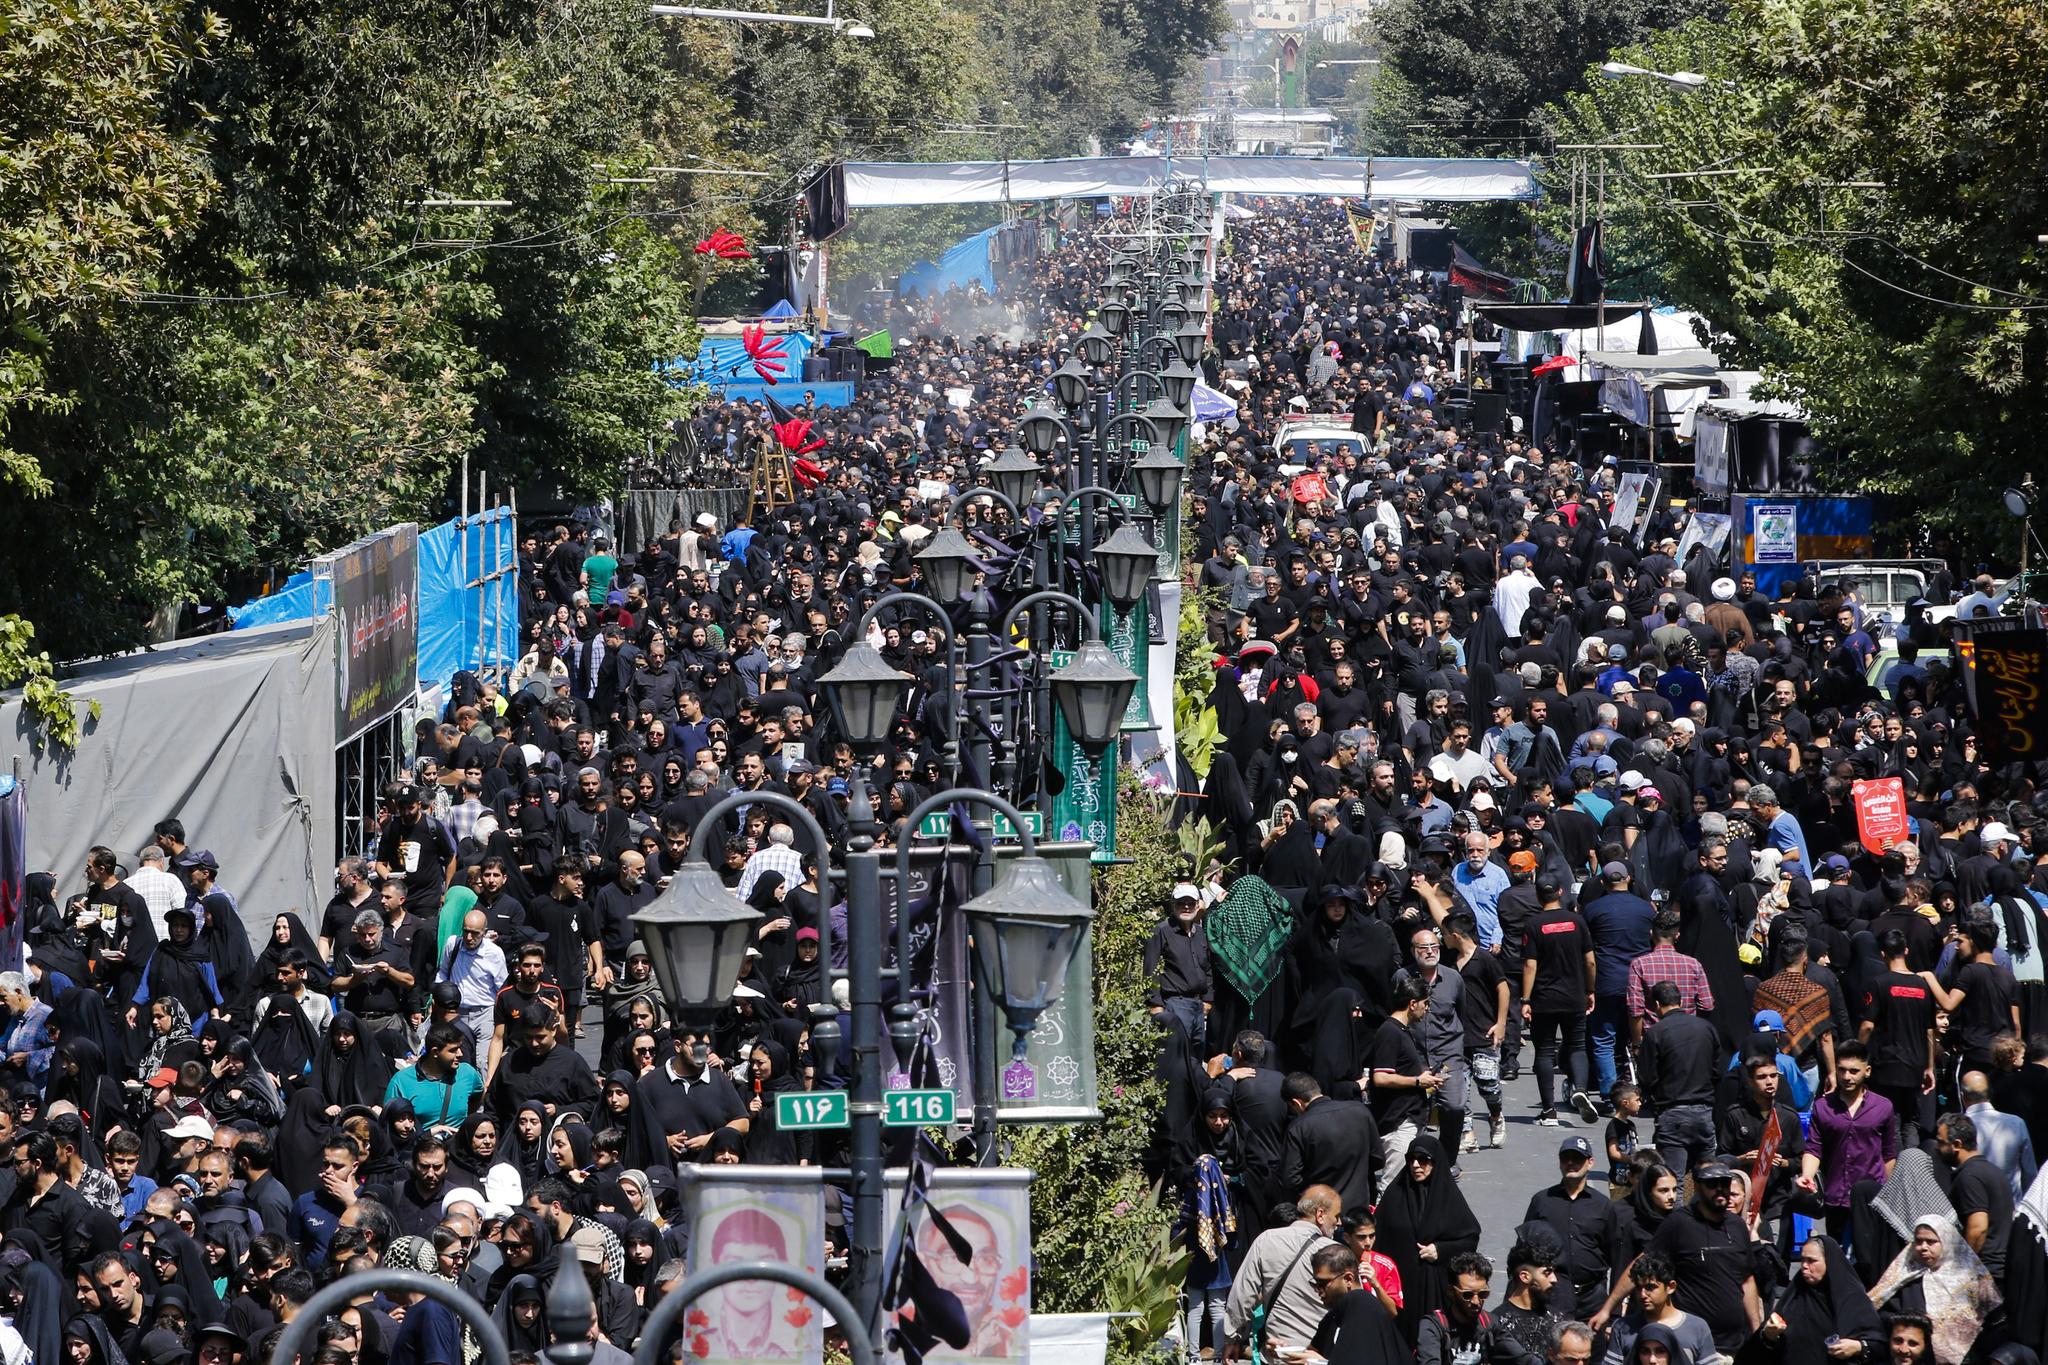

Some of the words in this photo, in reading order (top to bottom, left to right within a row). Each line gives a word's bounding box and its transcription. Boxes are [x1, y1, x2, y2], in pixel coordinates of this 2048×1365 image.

[1056, 653, 1072, 667] 11
[1001, 816, 1035, 833] 15
[792, 1097, 834, 1123] ۱۱۶
[895, 1096, 943, 1120] 116
